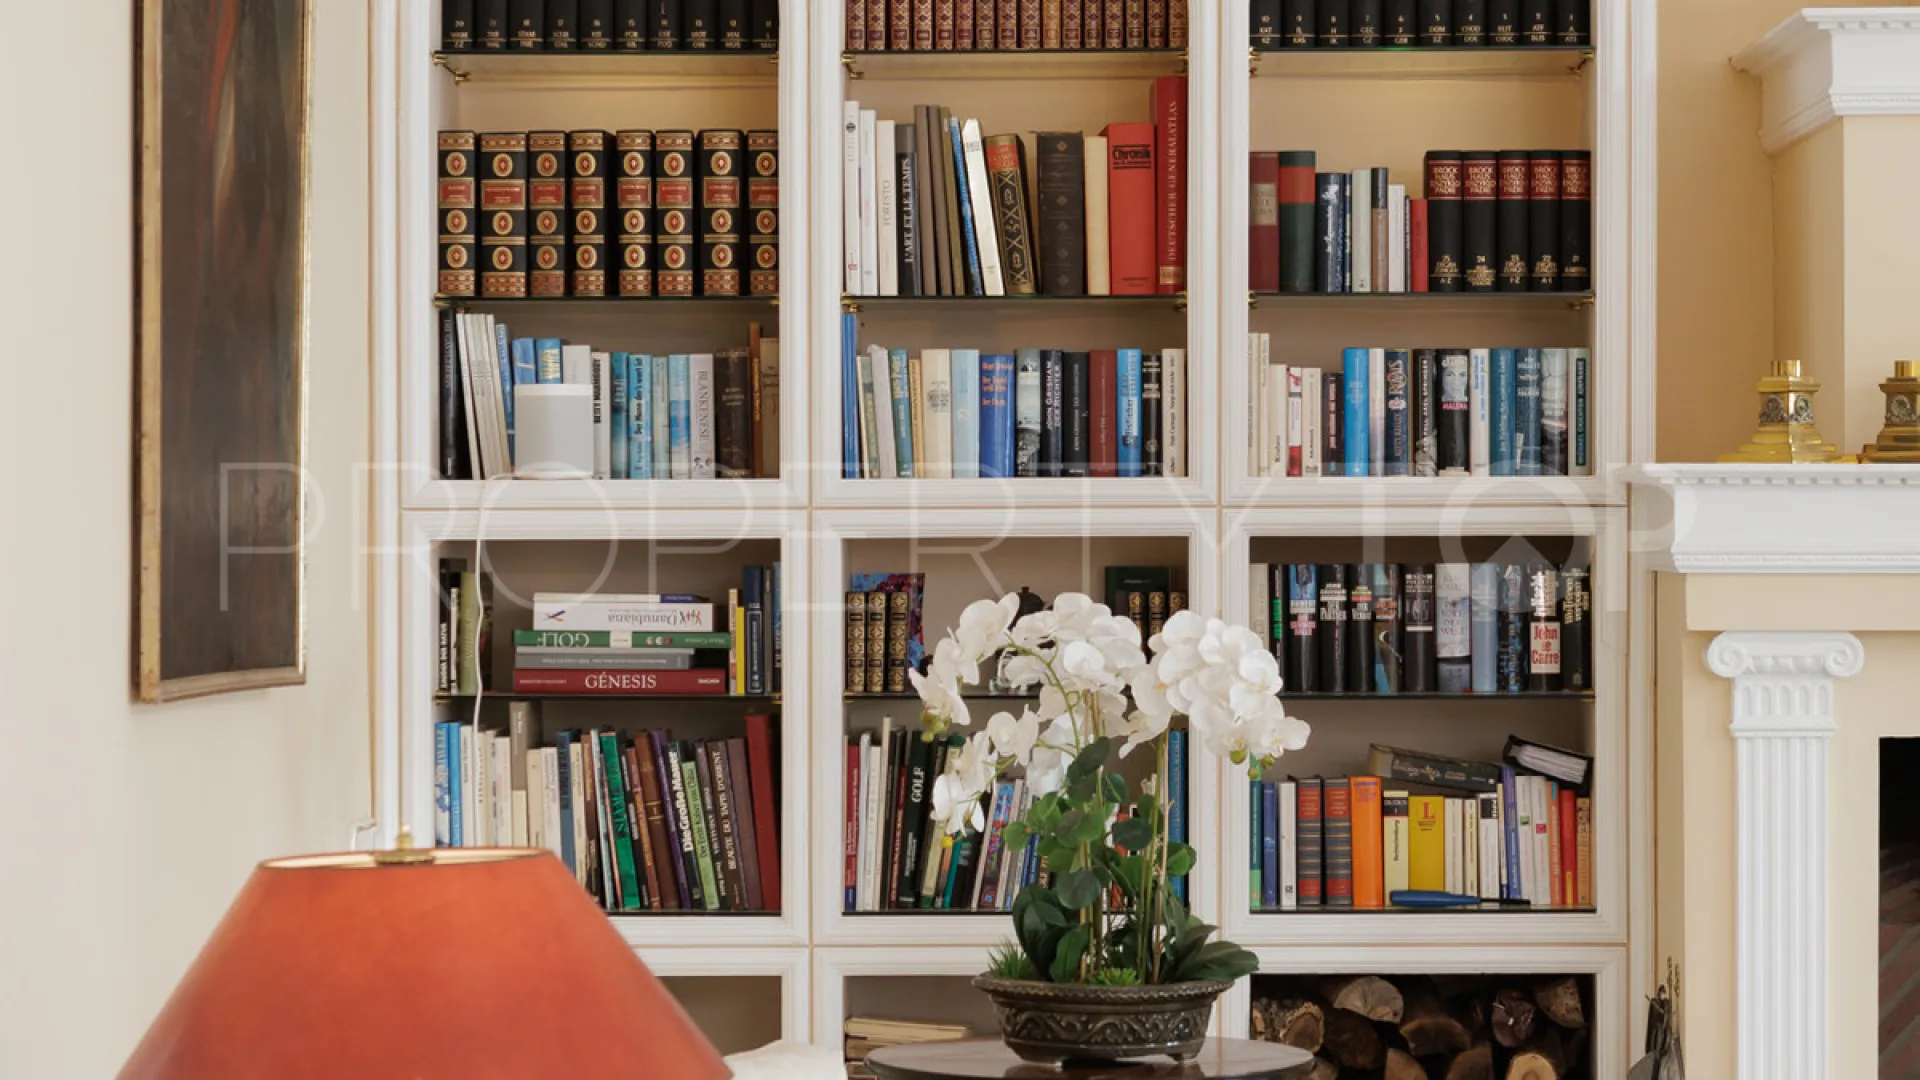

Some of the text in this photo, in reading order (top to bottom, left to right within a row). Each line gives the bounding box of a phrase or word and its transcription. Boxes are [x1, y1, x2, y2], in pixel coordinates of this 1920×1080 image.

[1166, 100, 1178, 261] DEUTSCHER GENERALATLAS
[902, 157, 913, 263] L'ART ET LE TEMPS
[1045, 360, 1053, 406] GRISHAM
[1421, 359, 1429, 396] SPRINGER
[634, 421, 643, 435] Der
[607, 612, 678, 626] Danubiana
[537, 632, 590, 648] GOLF
[1533, 625, 1558, 640] John
[585, 671, 657, 689] GÉNESIS
[669, 751, 682, 790] Mauer
[712, 751, 726, 793] D'ORIENT
[911, 766, 926, 803] GOLF
[719, 792, 730, 817] TAPIS
[722, 818, 731, 833] DU
[682, 829, 694, 852] Die
